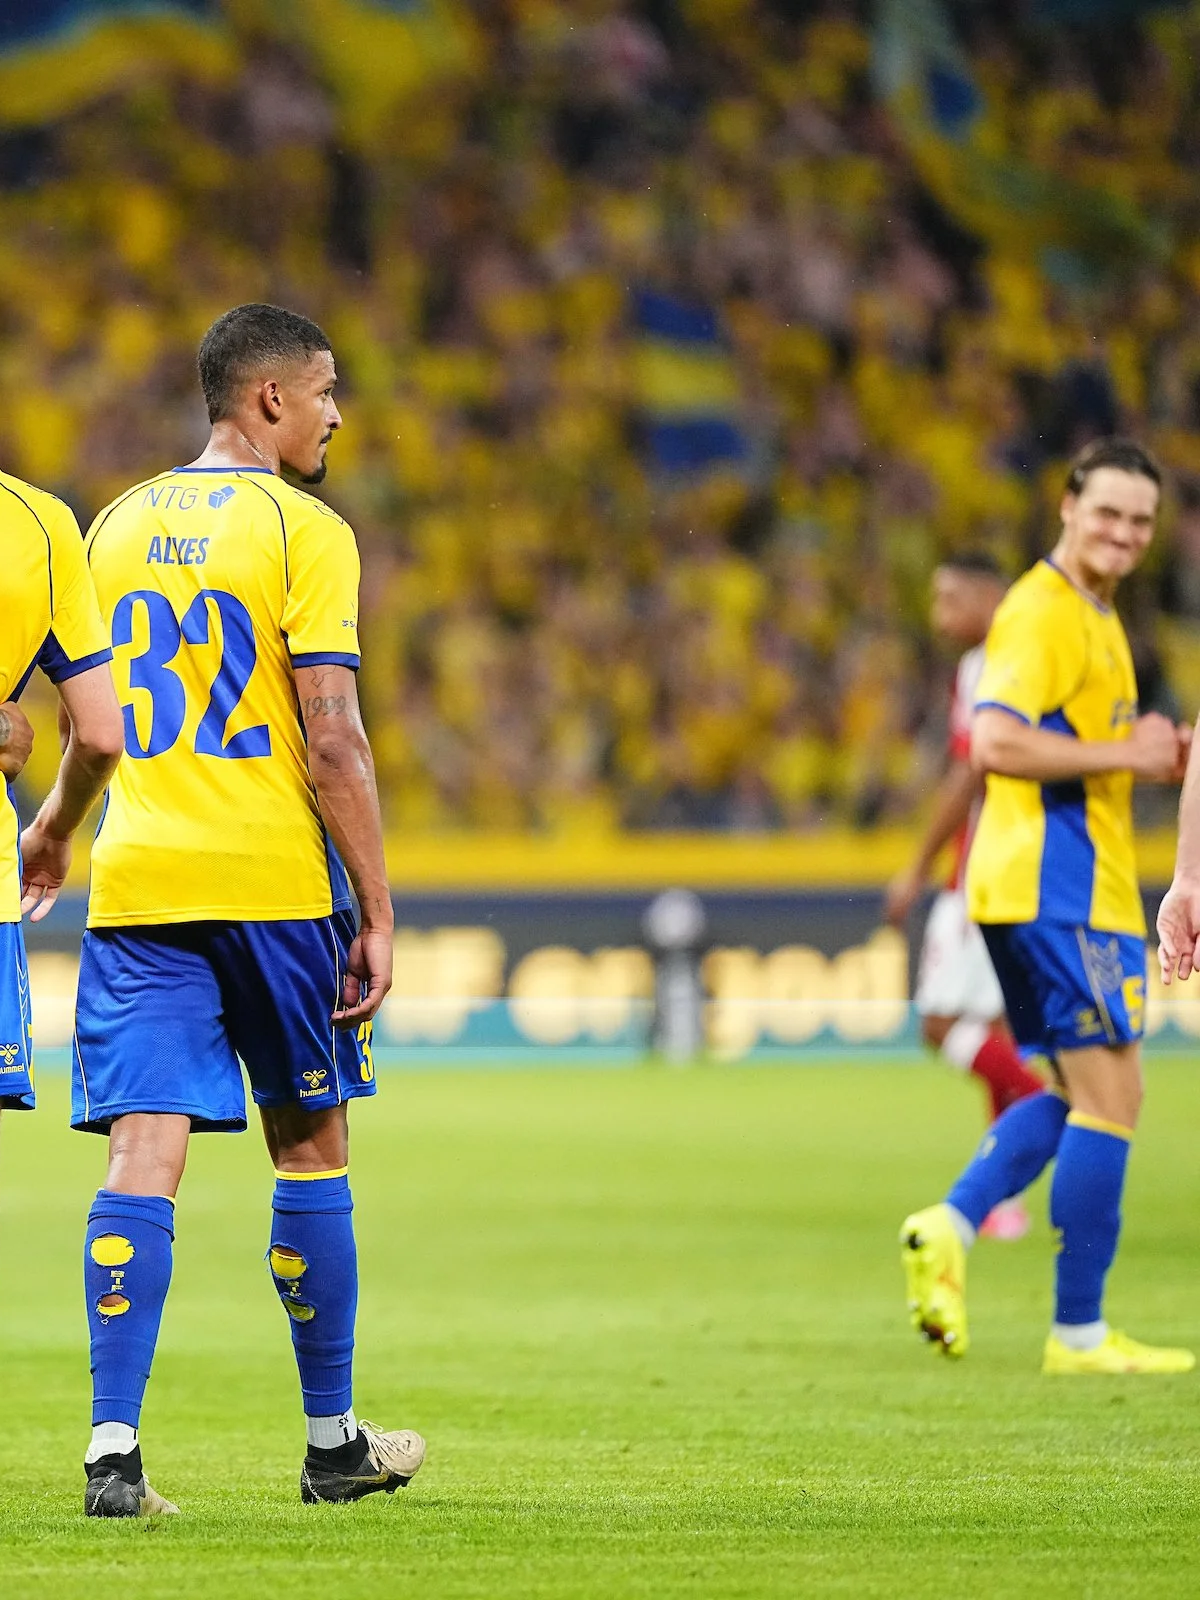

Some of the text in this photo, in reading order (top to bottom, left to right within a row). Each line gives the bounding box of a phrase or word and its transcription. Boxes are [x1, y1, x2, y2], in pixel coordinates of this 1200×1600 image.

[141, 485, 200, 511] NTG
[111, 588, 272, 759] 32
[299, 1084, 330, 1098] hummel
